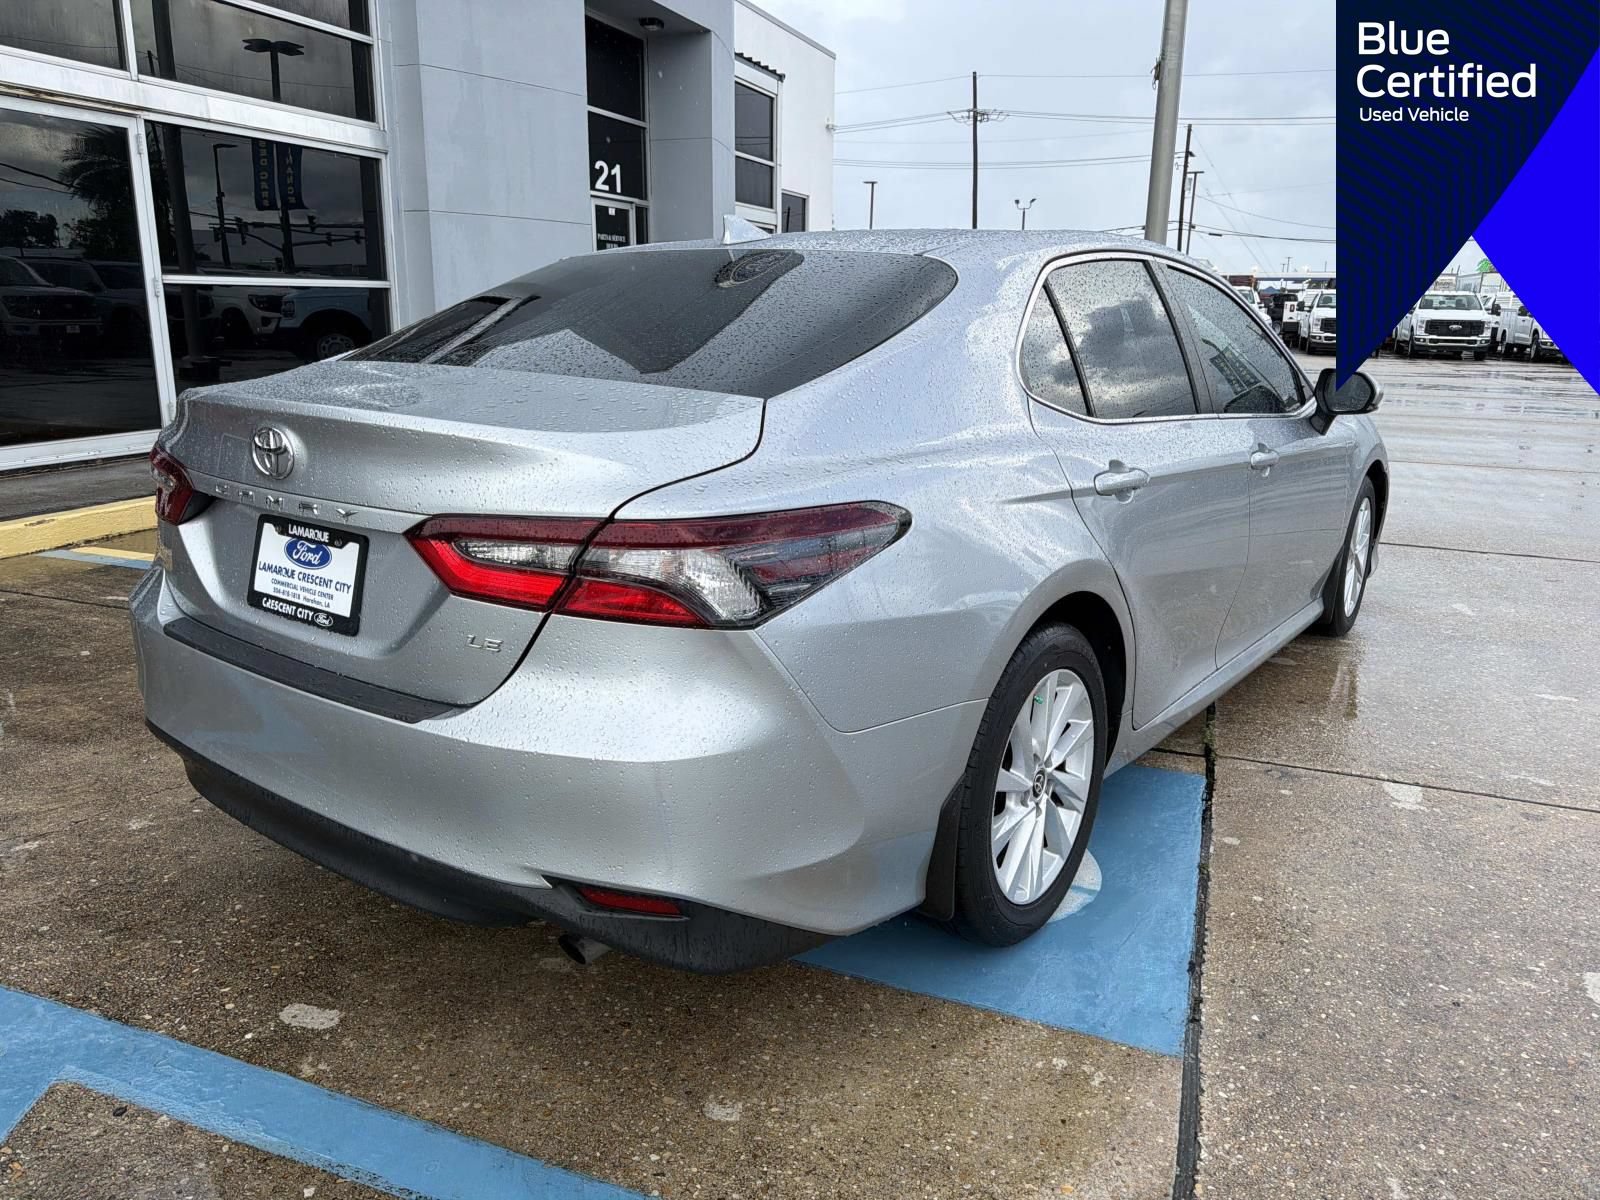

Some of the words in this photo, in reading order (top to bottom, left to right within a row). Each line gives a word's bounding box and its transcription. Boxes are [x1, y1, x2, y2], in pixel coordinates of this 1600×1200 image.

[594, 160, 622, 193] 21
[214, 483, 359, 524] CAMRY
[288, 523, 330, 543] LAMARQUE
[292, 540, 322, 565] Ford
[258, 561, 296, 580] LAMARQUE
[297, 571, 333, 589] CRESCENT
[334, 581, 352, 594] CITY
[271, 578, 299, 591] COMMERCIAL
[300, 586, 317, 596] VEHICLE
[317, 590, 334, 600] CENTER
[262, 597, 296, 616] CRESCENT
[296, 608, 314, 621] CITY
[324, 600, 331, 608] LA
[464, 634, 504, 653] LE
